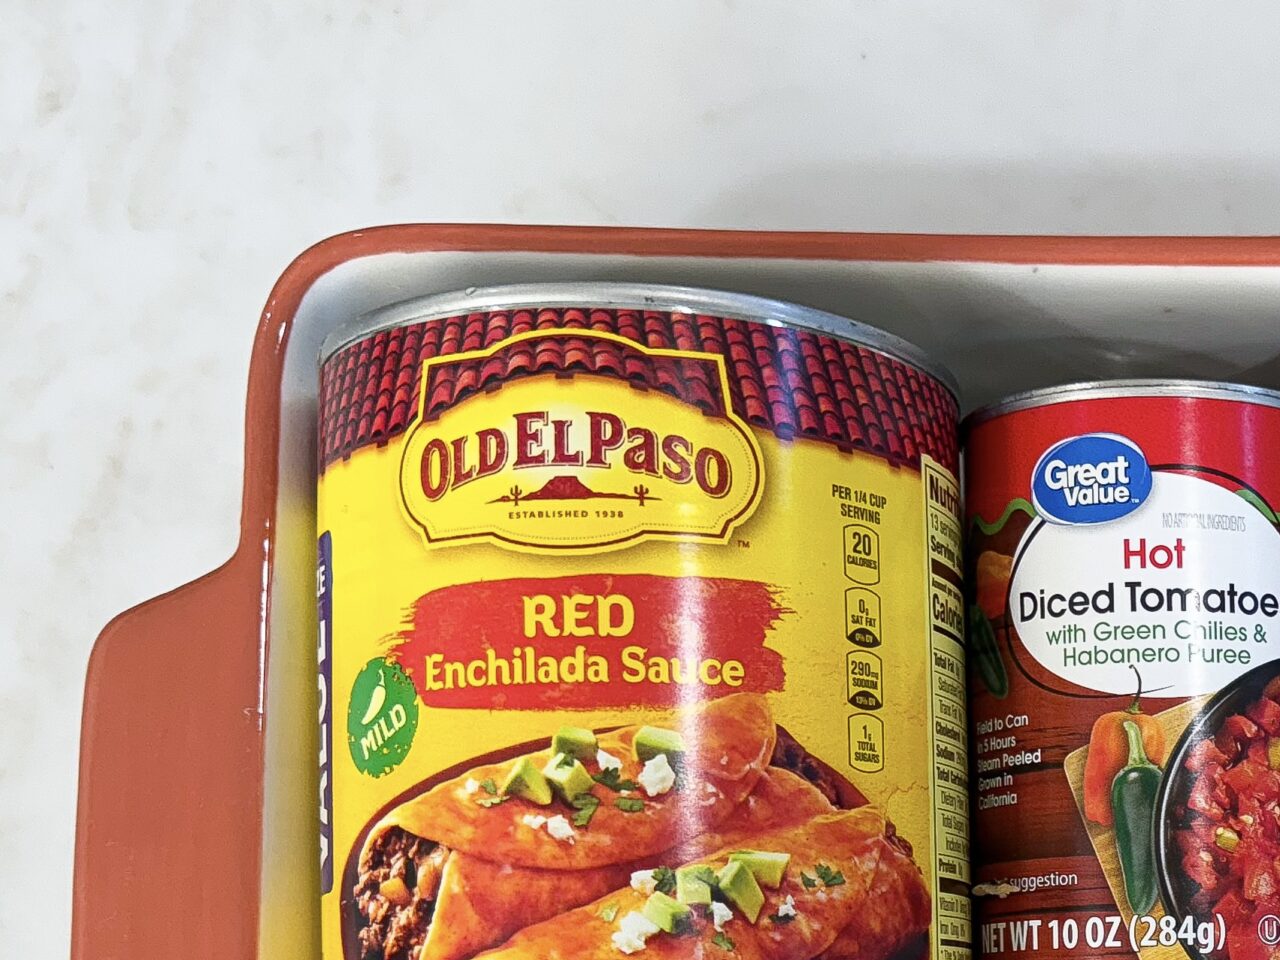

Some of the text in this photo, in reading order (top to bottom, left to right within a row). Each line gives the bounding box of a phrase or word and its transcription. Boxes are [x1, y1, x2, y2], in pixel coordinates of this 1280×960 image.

[419, 427, 510, 502] OLD
[1045, 455, 1129, 491] Great
[832, 484, 887, 510] PER 1/4 CUP
[1063, 483, 1131, 507] Value
[509, 510, 625, 520] ESTABLISHED 1938
[840, 503, 881, 525] SERVING
[852, 531, 872, 557] 20
[1122, 537, 1187, 570] Hot
[521, 592, 637, 638] RED
[1019, 582, 1115, 624] Diced
[1045, 620, 1268, 646] with Green Chilies &
[424, 645, 746, 691] Enchilada Sauce
[1062, 644, 1252, 668] Habanero Puree
[852, 677, 879, 691] SODIUM
[359, 700, 409, 761] MILD
[994, 716, 1004, 731] to
[1005, 714, 1029, 729] Can
[857, 741, 877, 753] TOTAL
[990, 735, 1017, 751] Hours
[854, 751, 880, 764] SUGARS
[1002, 748, 1042, 768] Peeled
[1003, 772, 1014, 787] in
[978, 790, 1018, 811] California
[1008, 872, 1078, 894] suggestion
[981, 922, 1007, 954] NET
[1009, 919, 1042, 952] WT
[1047, 917, 1079, 950] 10
[1085, 915, 1122, 949] OZ
[1128, 913, 1227, 954] (284g)
